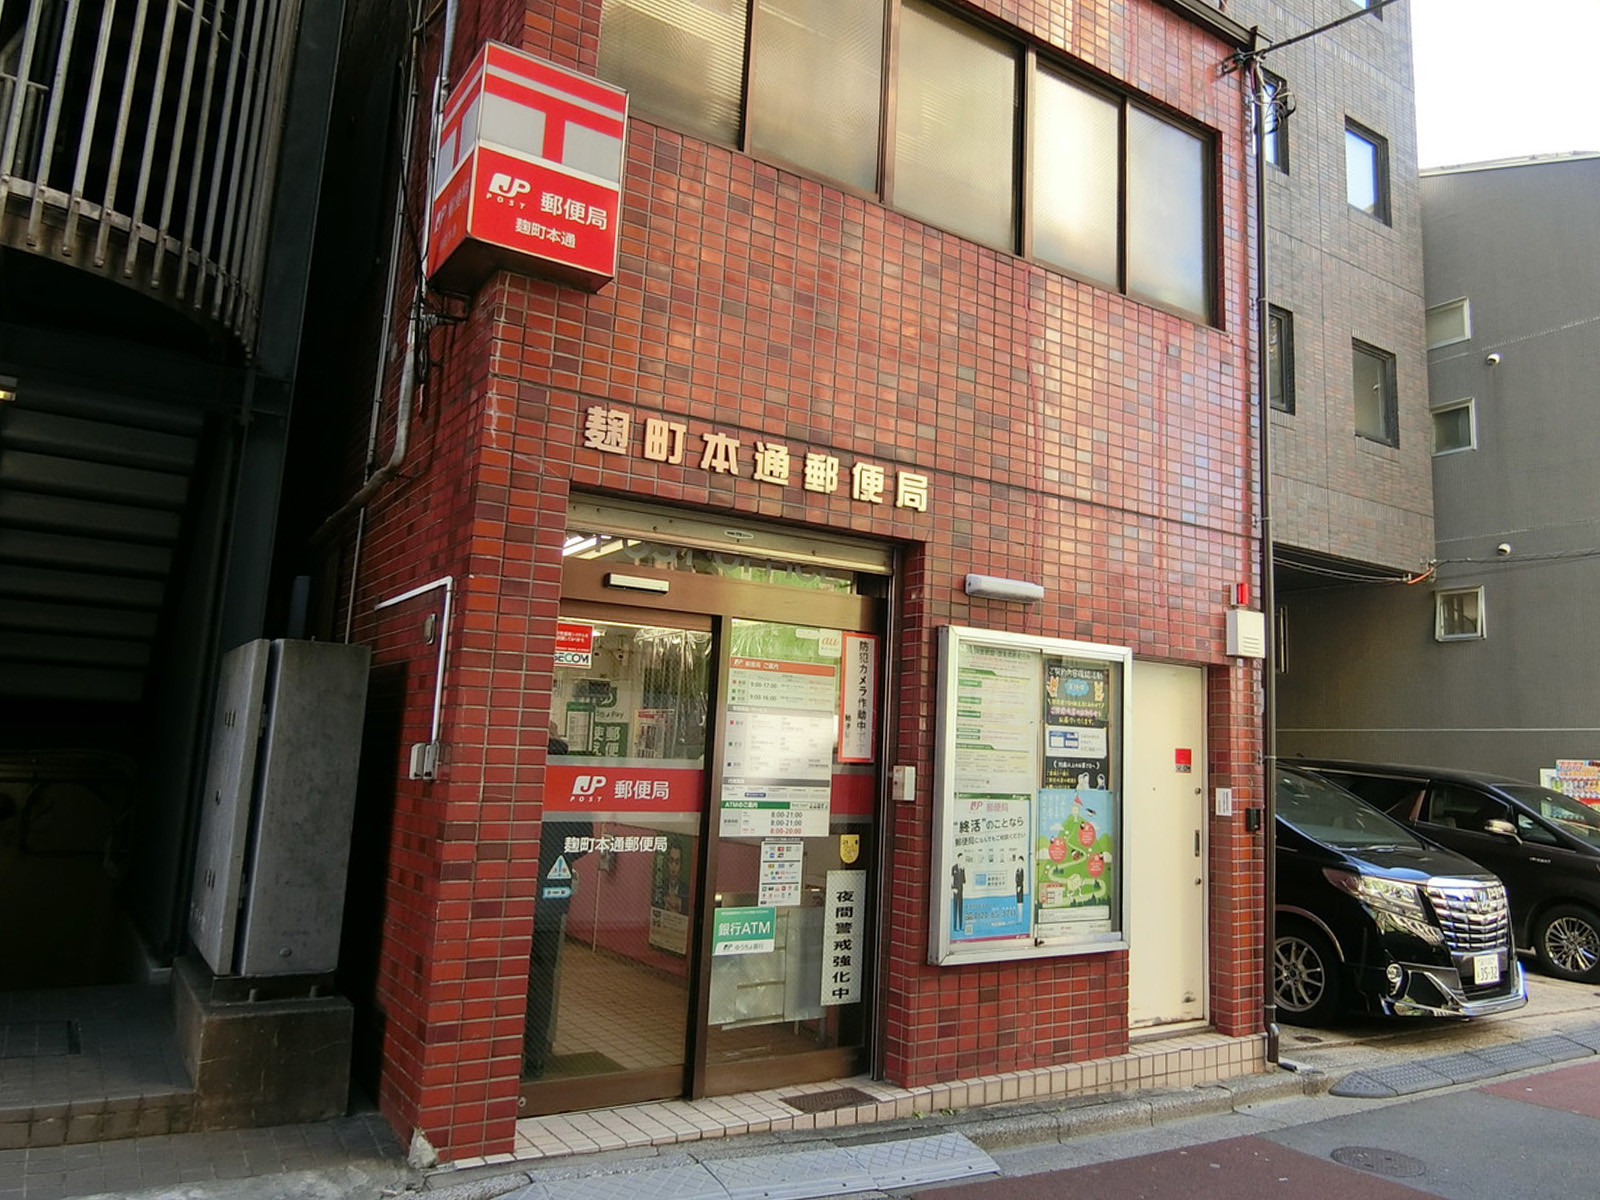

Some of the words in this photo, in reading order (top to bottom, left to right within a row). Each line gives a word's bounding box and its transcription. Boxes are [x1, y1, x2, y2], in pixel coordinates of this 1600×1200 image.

[489, 172, 531, 197] JP
[486, 193, 526, 210] POST
[540, 192, 608, 231] 郵便局
[572, 775, 607, 796] JP
[614, 780, 670, 800] 郵便局
[718, 921, 771, 936] 銀行ATM
[832, 890, 854, 999] 夜間警戒強化中
